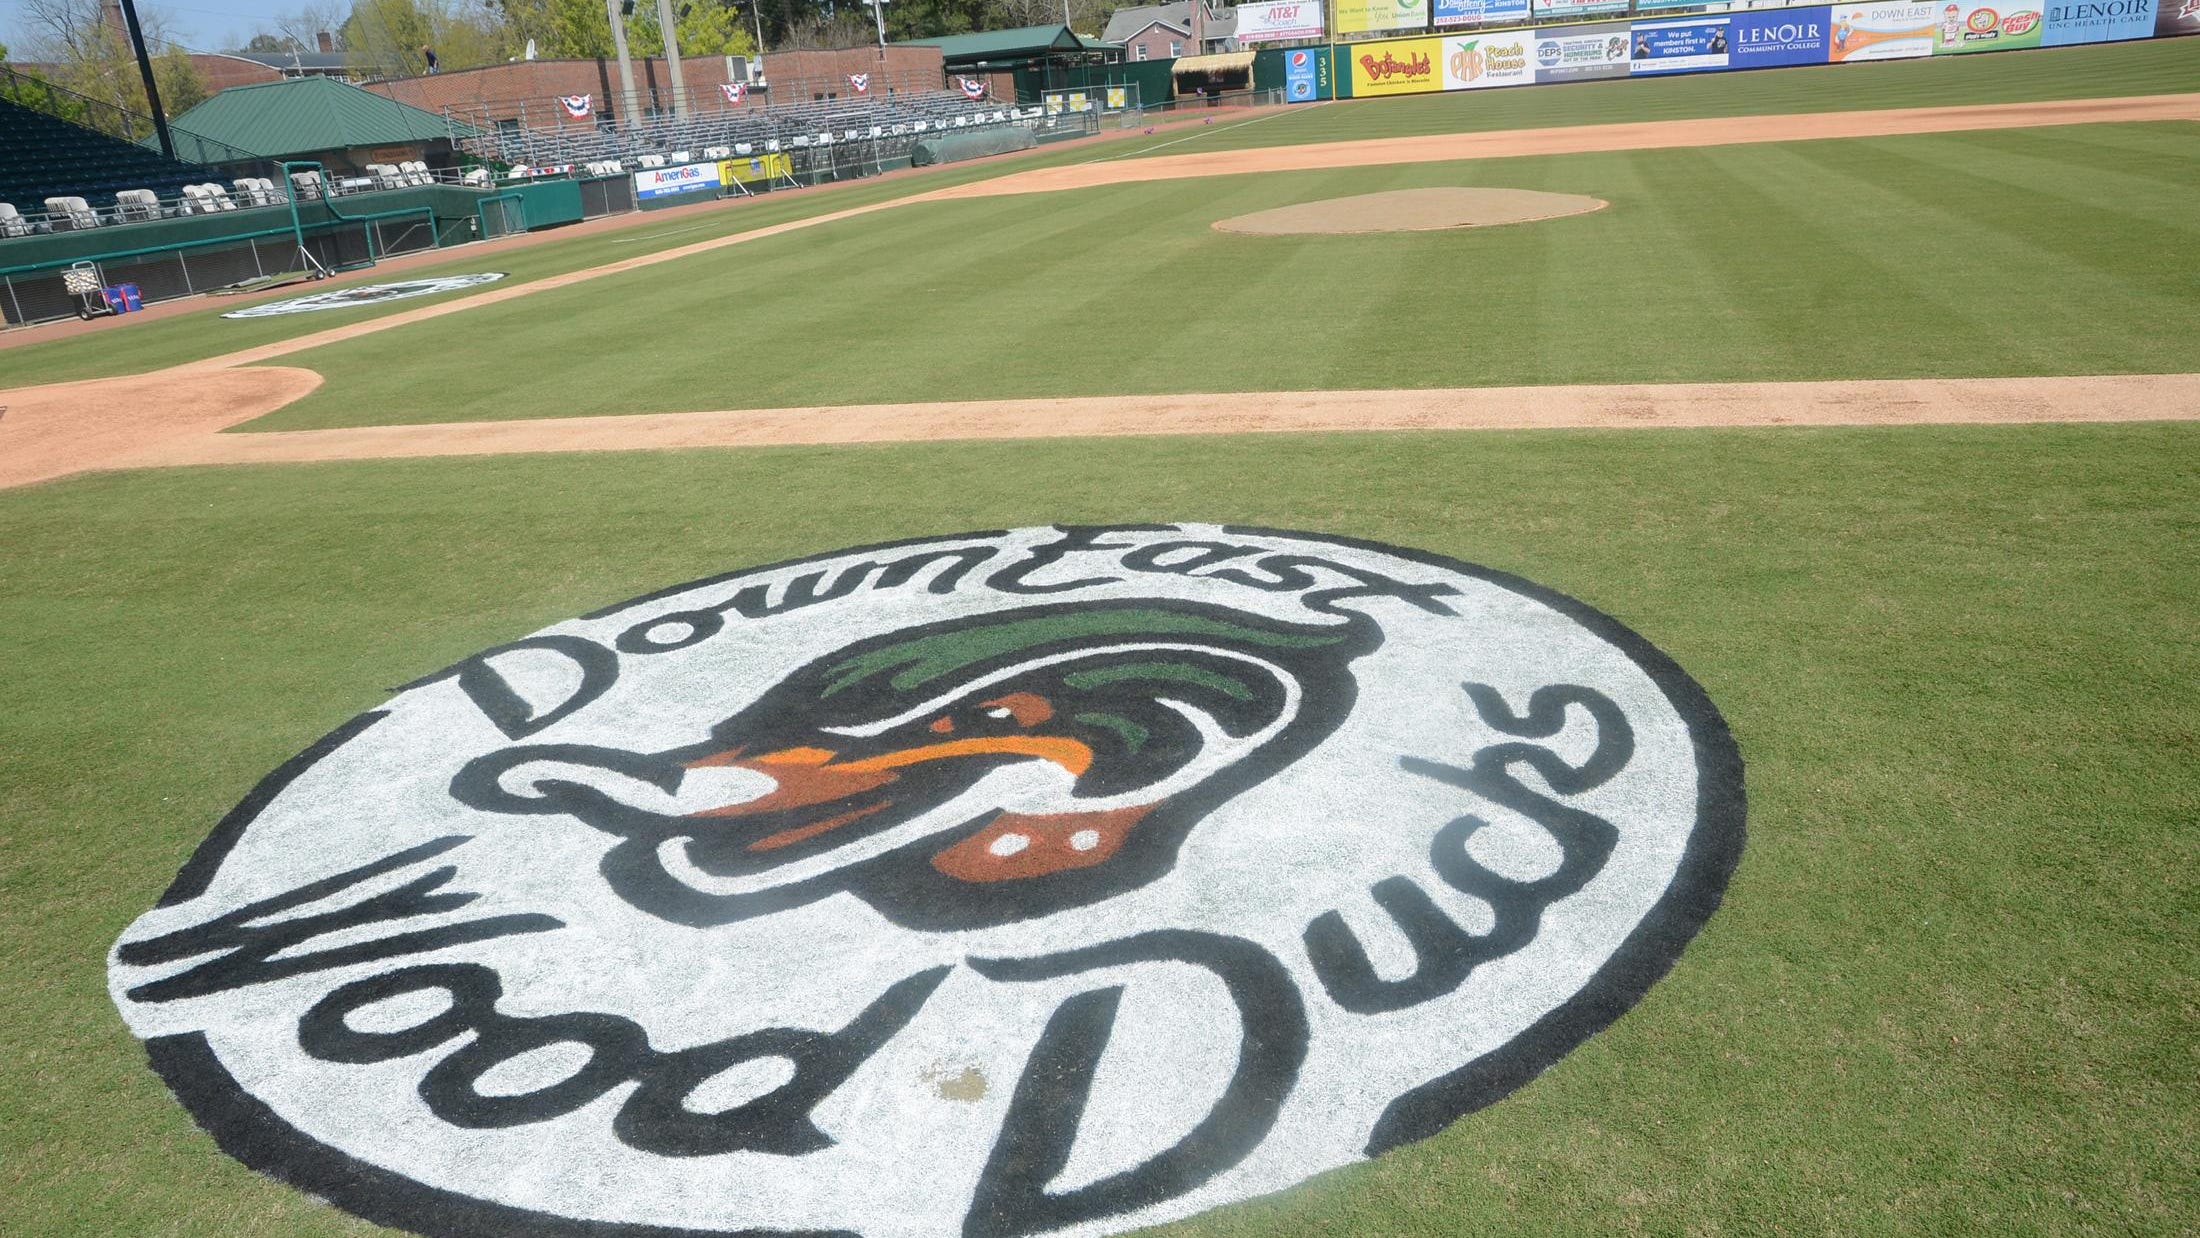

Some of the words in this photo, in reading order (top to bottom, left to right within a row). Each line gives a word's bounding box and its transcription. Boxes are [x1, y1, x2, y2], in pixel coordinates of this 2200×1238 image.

[1268, 5, 1300, 19] AT&T
[1872, 9, 1904, 20] DOWN
[1907, 7, 1933, 17] EAST
[2064, 0, 2149, 20] LENOIR
[2074, 19, 2116, 28] HEALTH
[2121, 15, 2149, 23] CARE
[1680, 31, 1693, 39] put
[1737, 24, 1821, 43] LENOIR
[1484, 42, 1524, 57] Peach
[1537, 47, 1562, 58] DEPS
[1663, 46, 1696, 54] KINSTON.
[1737, 44, 1786, 53] COMMUNITY
[1787, 42, 1821, 50] COLLEGE
[1484, 57, 1526, 71] House
[1319, 57, 1327, 87] 335
[654, 167, 700, 184] AmeriGas
[458, 546, 1003, 738] Down
[961, 682, 1636, 1238] Ducks
[116, 834, 957, 1157] Wood
